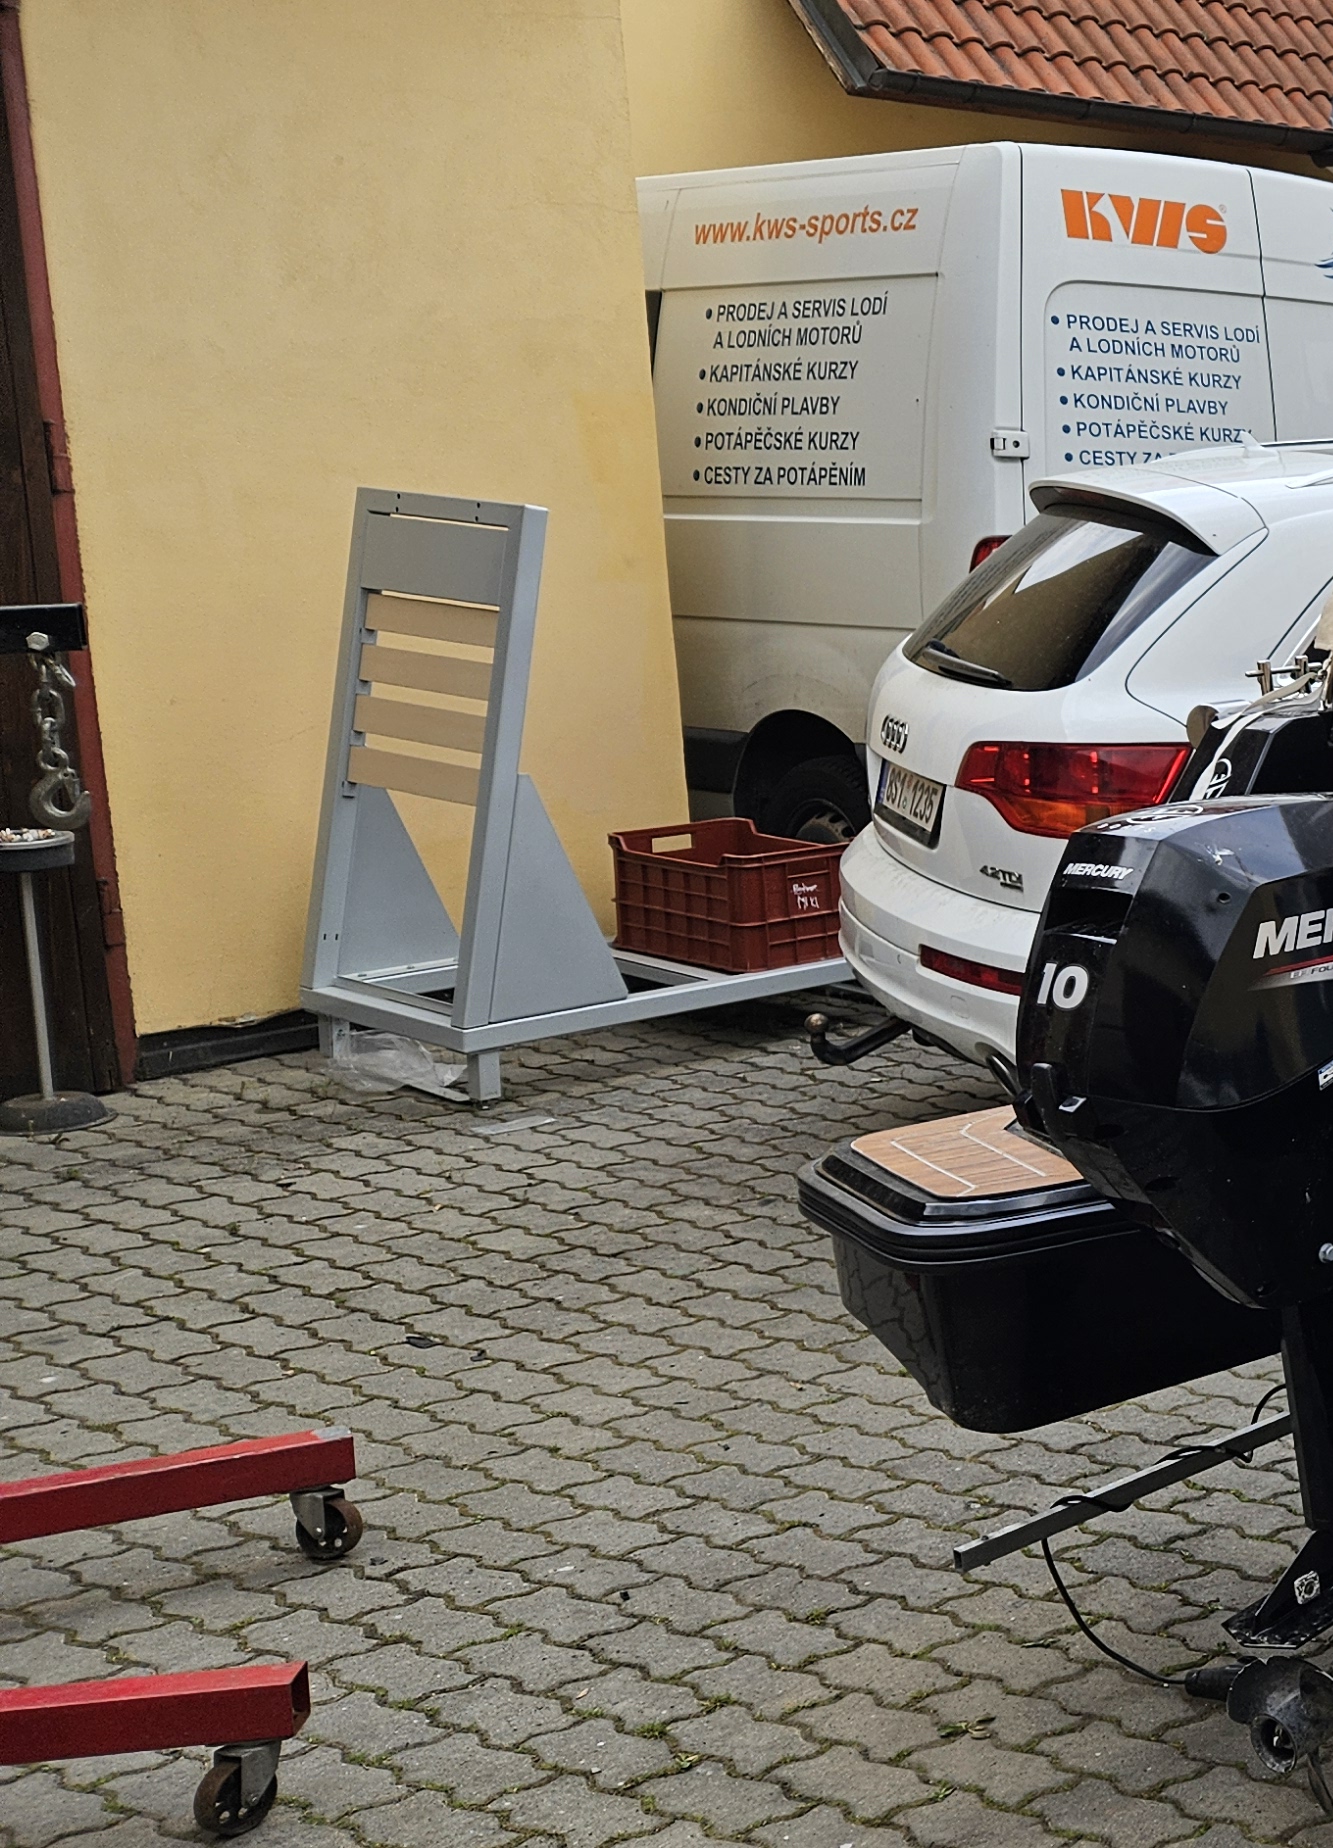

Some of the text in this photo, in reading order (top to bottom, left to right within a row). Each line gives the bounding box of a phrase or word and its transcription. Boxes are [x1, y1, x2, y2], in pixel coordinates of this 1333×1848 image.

[694, 205, 920, 245] www.kws-sports.cz
[1060, 188, 1229, 255] KWS
[716, 290, 889, 323] PRODEJ A SERVIS LODÍ
[712, 320, 864, 349] A LODNÍCH MOTORŮ
[1066, 313, 1261, 344] PRODEJ A SERVIS LODÍ
[1068, 336, 1241, 364] A LODNÍCH MOTORŮ
[708, 356, 860, 383] KAPITÁNSKÉ KURZY
[1070, 364, 1243, 390] KAPITÁNSKÉ KURZY
[706, 391, 841, 417] KONDIČNÍ PLAVBY
[1072, 392, 1229, 416] KONDIČNÍ PLAVBY
[703, 426, 861, 451] POTÁPĚČSKÉ KURZY
[1075, 418, 1195, 442] POTÁPĚČSKÉ
[1078, 449, 1139, 467] CESTY
[703, 462, 867, 487] CESTY ZA POTÁPĚNÍM
[1063, 862, 1135, 881] MERCURY
[1036, 961, 1089, 1010] 10
